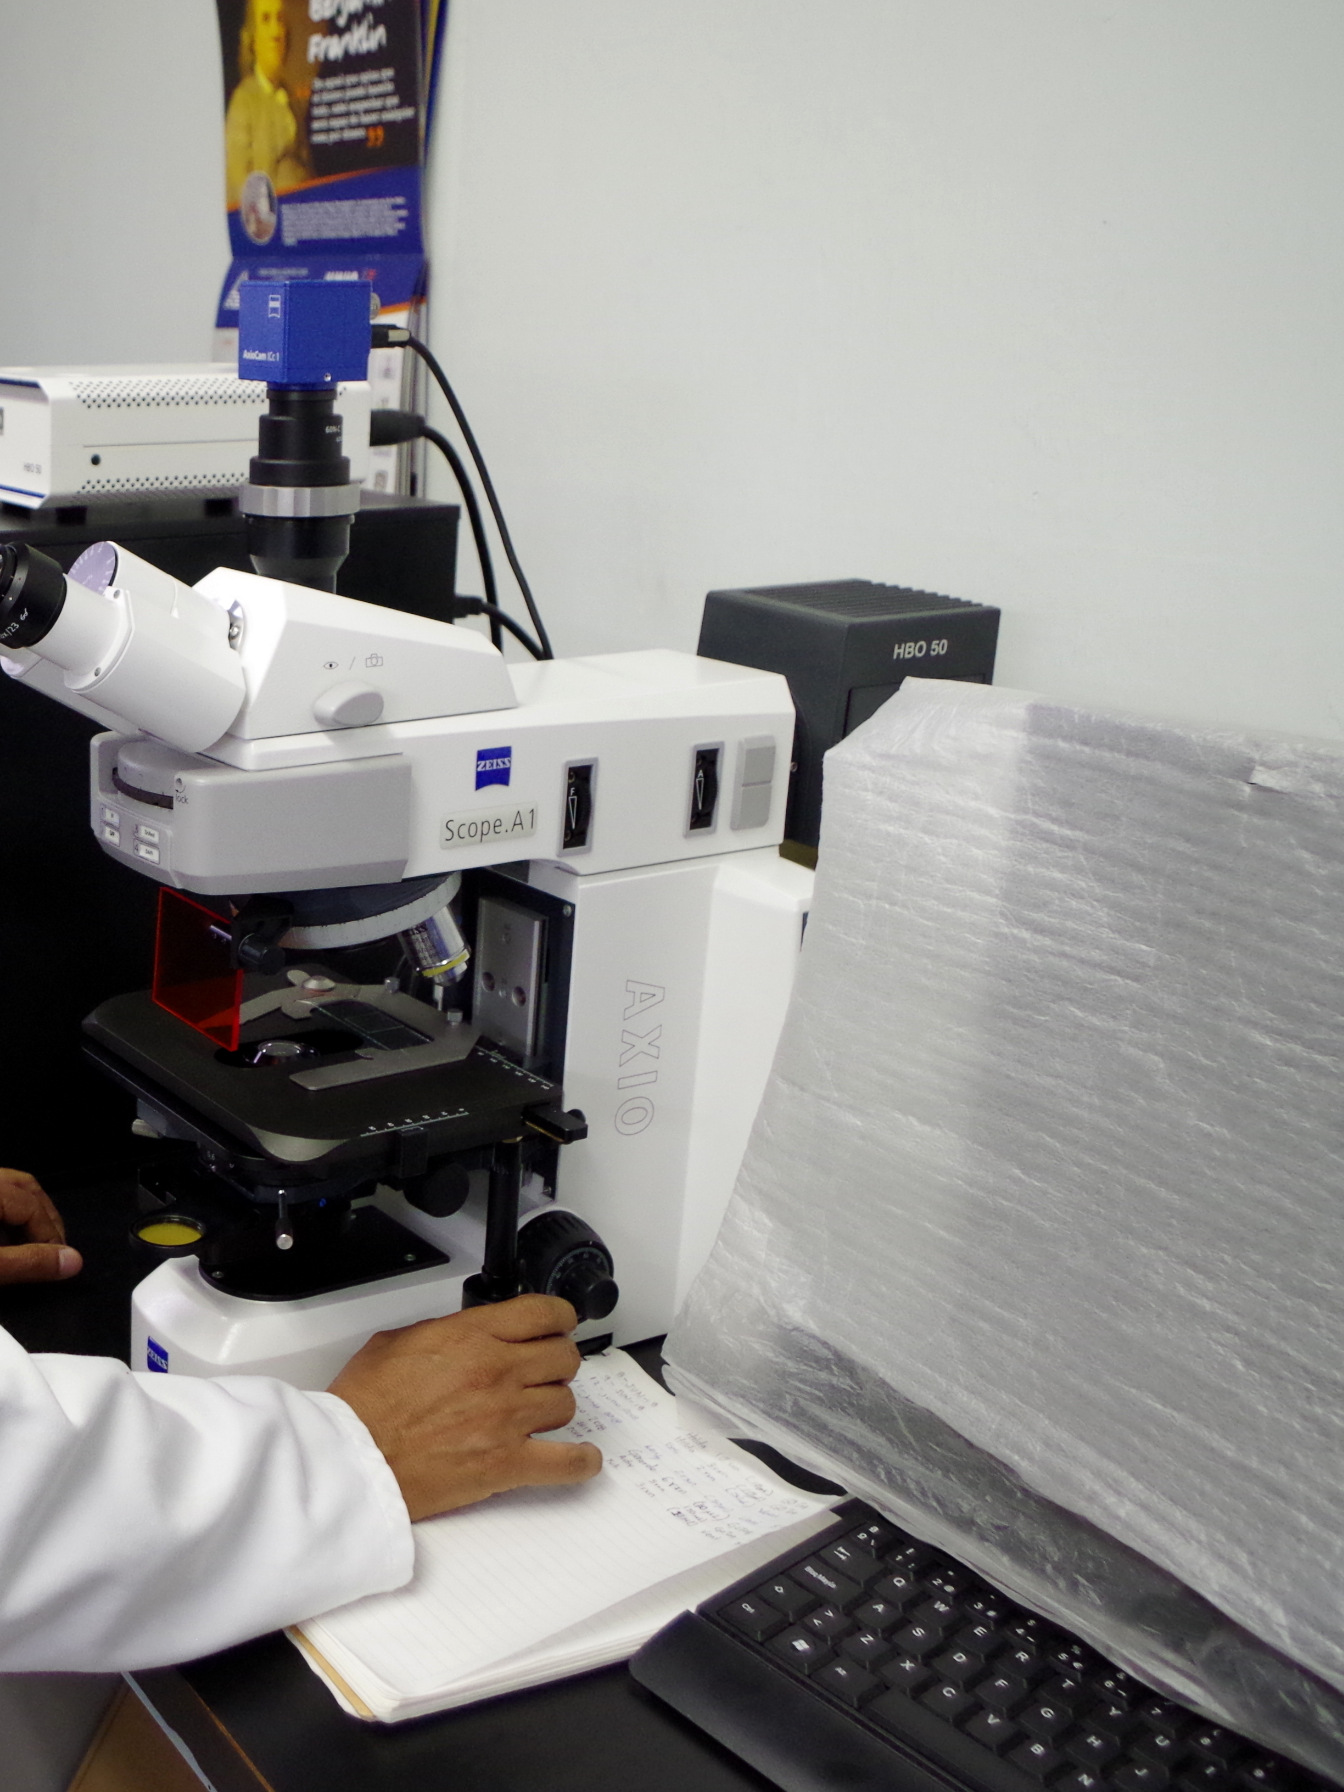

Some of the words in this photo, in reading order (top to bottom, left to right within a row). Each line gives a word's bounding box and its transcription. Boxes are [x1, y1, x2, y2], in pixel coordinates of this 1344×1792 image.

[307, 11, 387, 64] Franklin
[243, 349, 267, 361] AxioCam
[893, 640, 927, 660] HBO
[930, 639, 948, 656] 50
[477, 757, 511, 771] ZEISS
[445, 808, 534, 843] Scope.A1
[614, 979, 665, 1136] AXIO
[893, 1577, 906, 1587] Q
[932, 1578, 943, 1586] 2
[872, 1603, 885, 1613] A
[933, 1601, 950, 1613] W
[973, 1602, 983, 1610] 3
[912, 1627, 925, 1637] S
[973, 1626, 988, 1637] E
[860, 1634, 874, 1645] Z
[953, 1652, 967, 1663] D
[1015, 1651, 1030, 1662] R
[900, 1660, 915, 1671] X
[995, 1679, 1009, 1688] F
[1062, 1678, 1075, 1689] T
[942, 1687, 956, 1698] C
[1040, 1707, 1055, 1718] G
[1109, 1706, 1122, 1716] Y
[987, 1713, 1001, 1725] V
[1087, 1735, 1103, 1748] H
[1155, 1736, 1170, 1747] U
[1030, 1743, 1045, 1756] B
[1134, 1768, 1148, 1777] J
[1078, 1773, 1095, 1787] N
